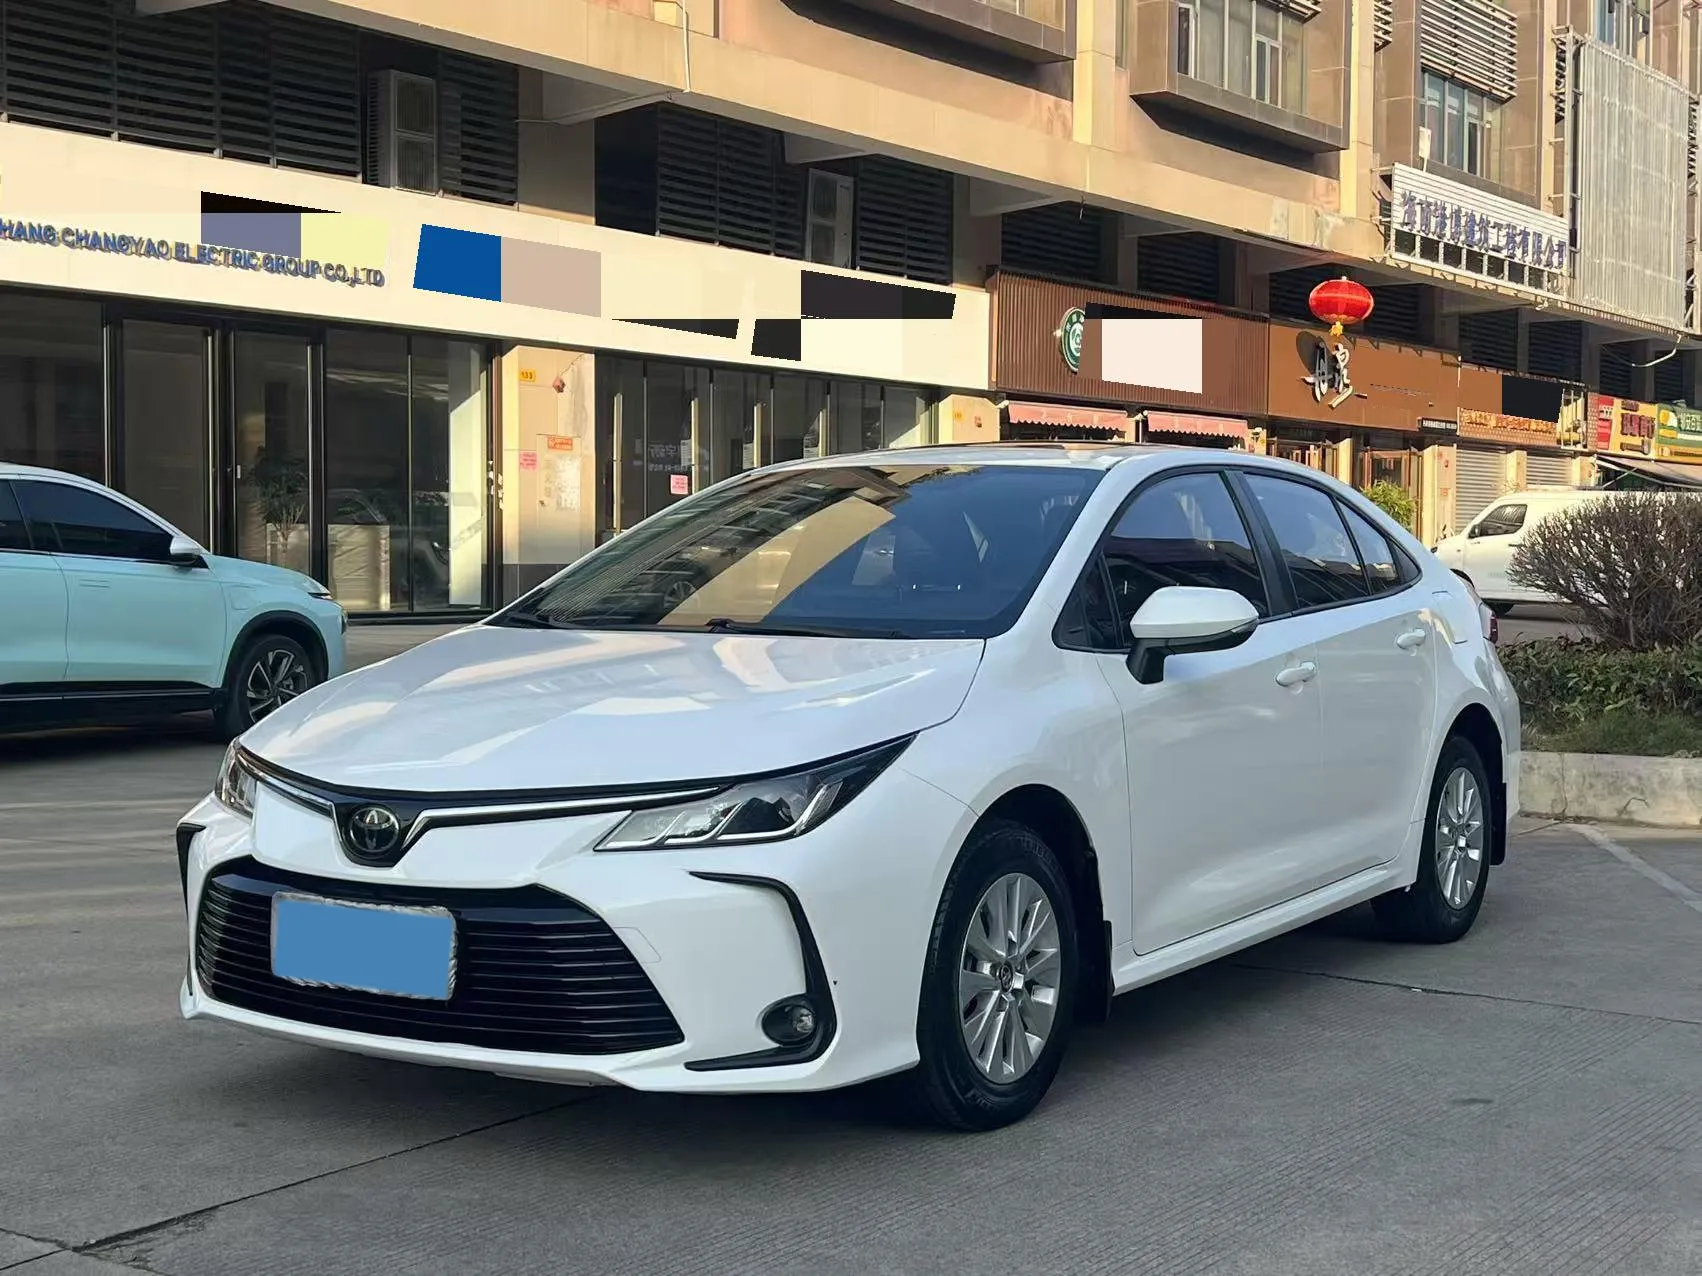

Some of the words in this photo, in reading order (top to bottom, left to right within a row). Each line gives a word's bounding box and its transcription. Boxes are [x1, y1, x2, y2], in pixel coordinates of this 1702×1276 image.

[61, 226, 172, 260] CHANGYAO
[175, 241, 260, 271] ELECTRIC
[262, 253, 322, 280] GROUP
